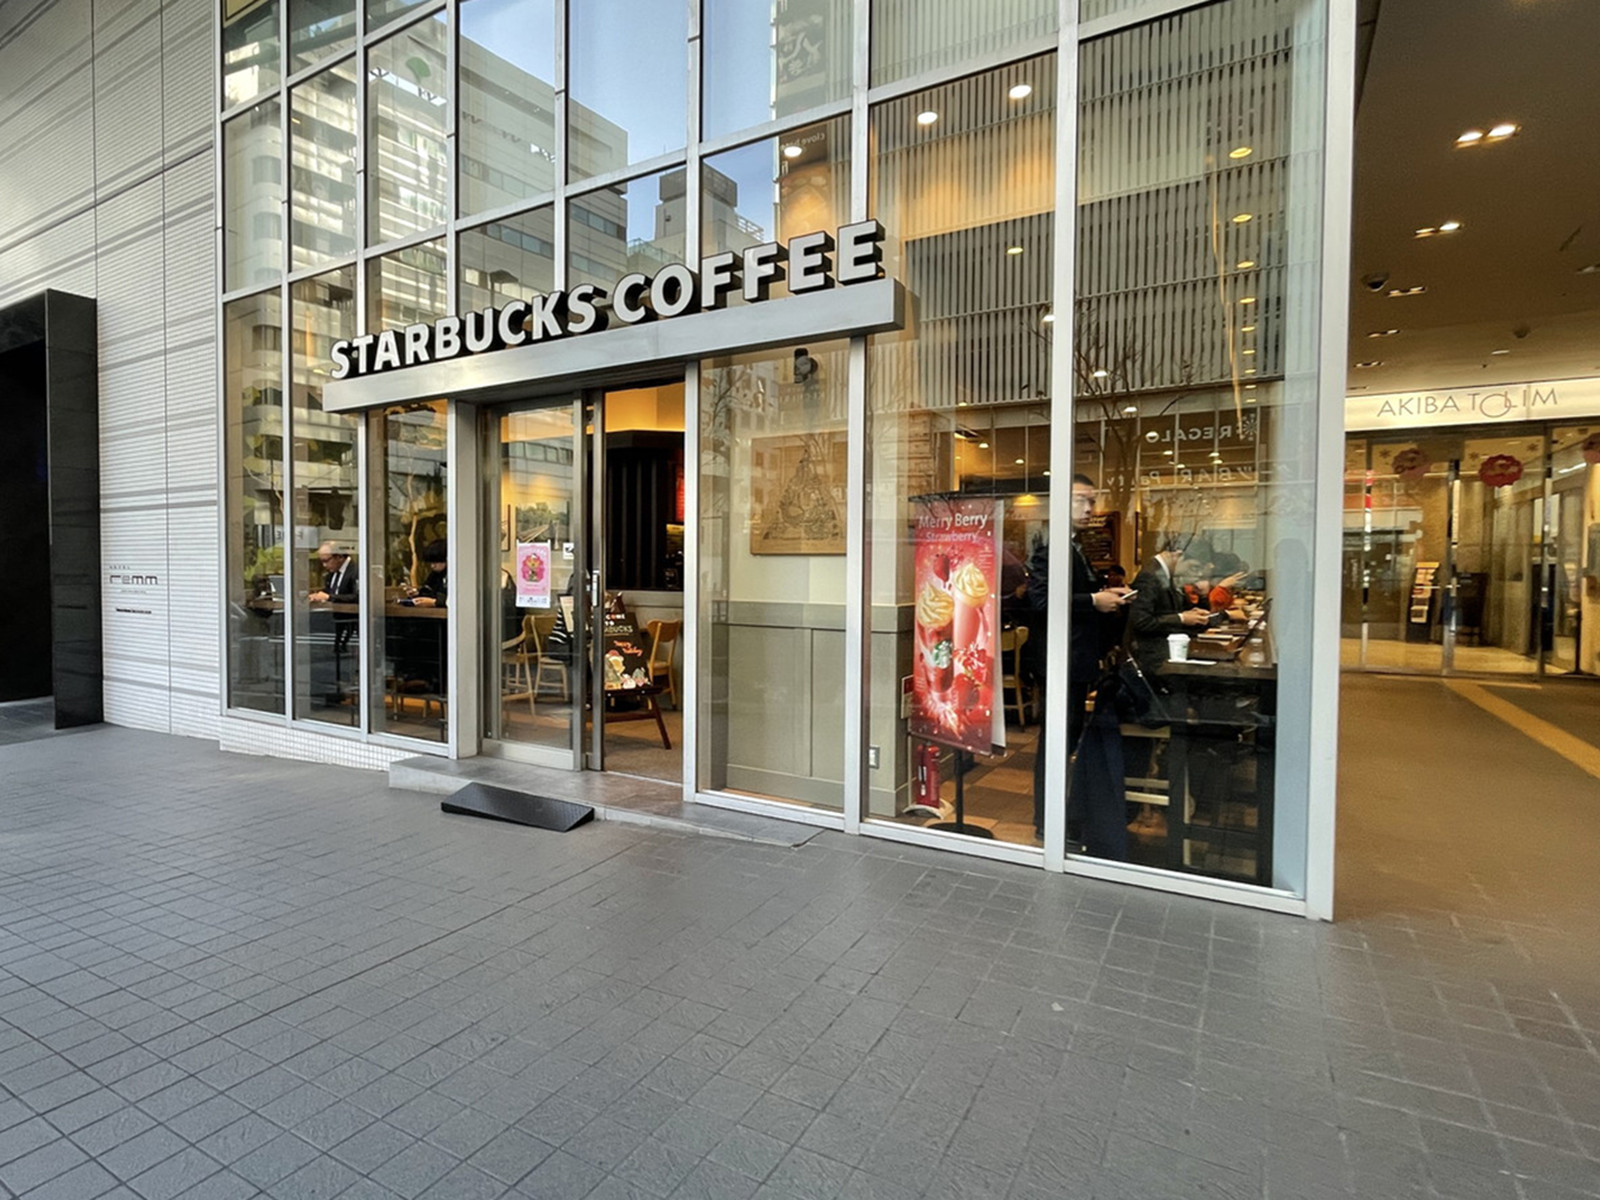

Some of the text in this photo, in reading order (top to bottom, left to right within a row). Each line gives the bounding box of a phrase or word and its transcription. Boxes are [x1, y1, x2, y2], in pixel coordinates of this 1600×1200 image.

[331, 219, 882, 379] STARBUCKS COFFEE
[1377, 388, 1558, 418] AKIBA TOLIM
[918, 512, 988, 531] Merry Berry
